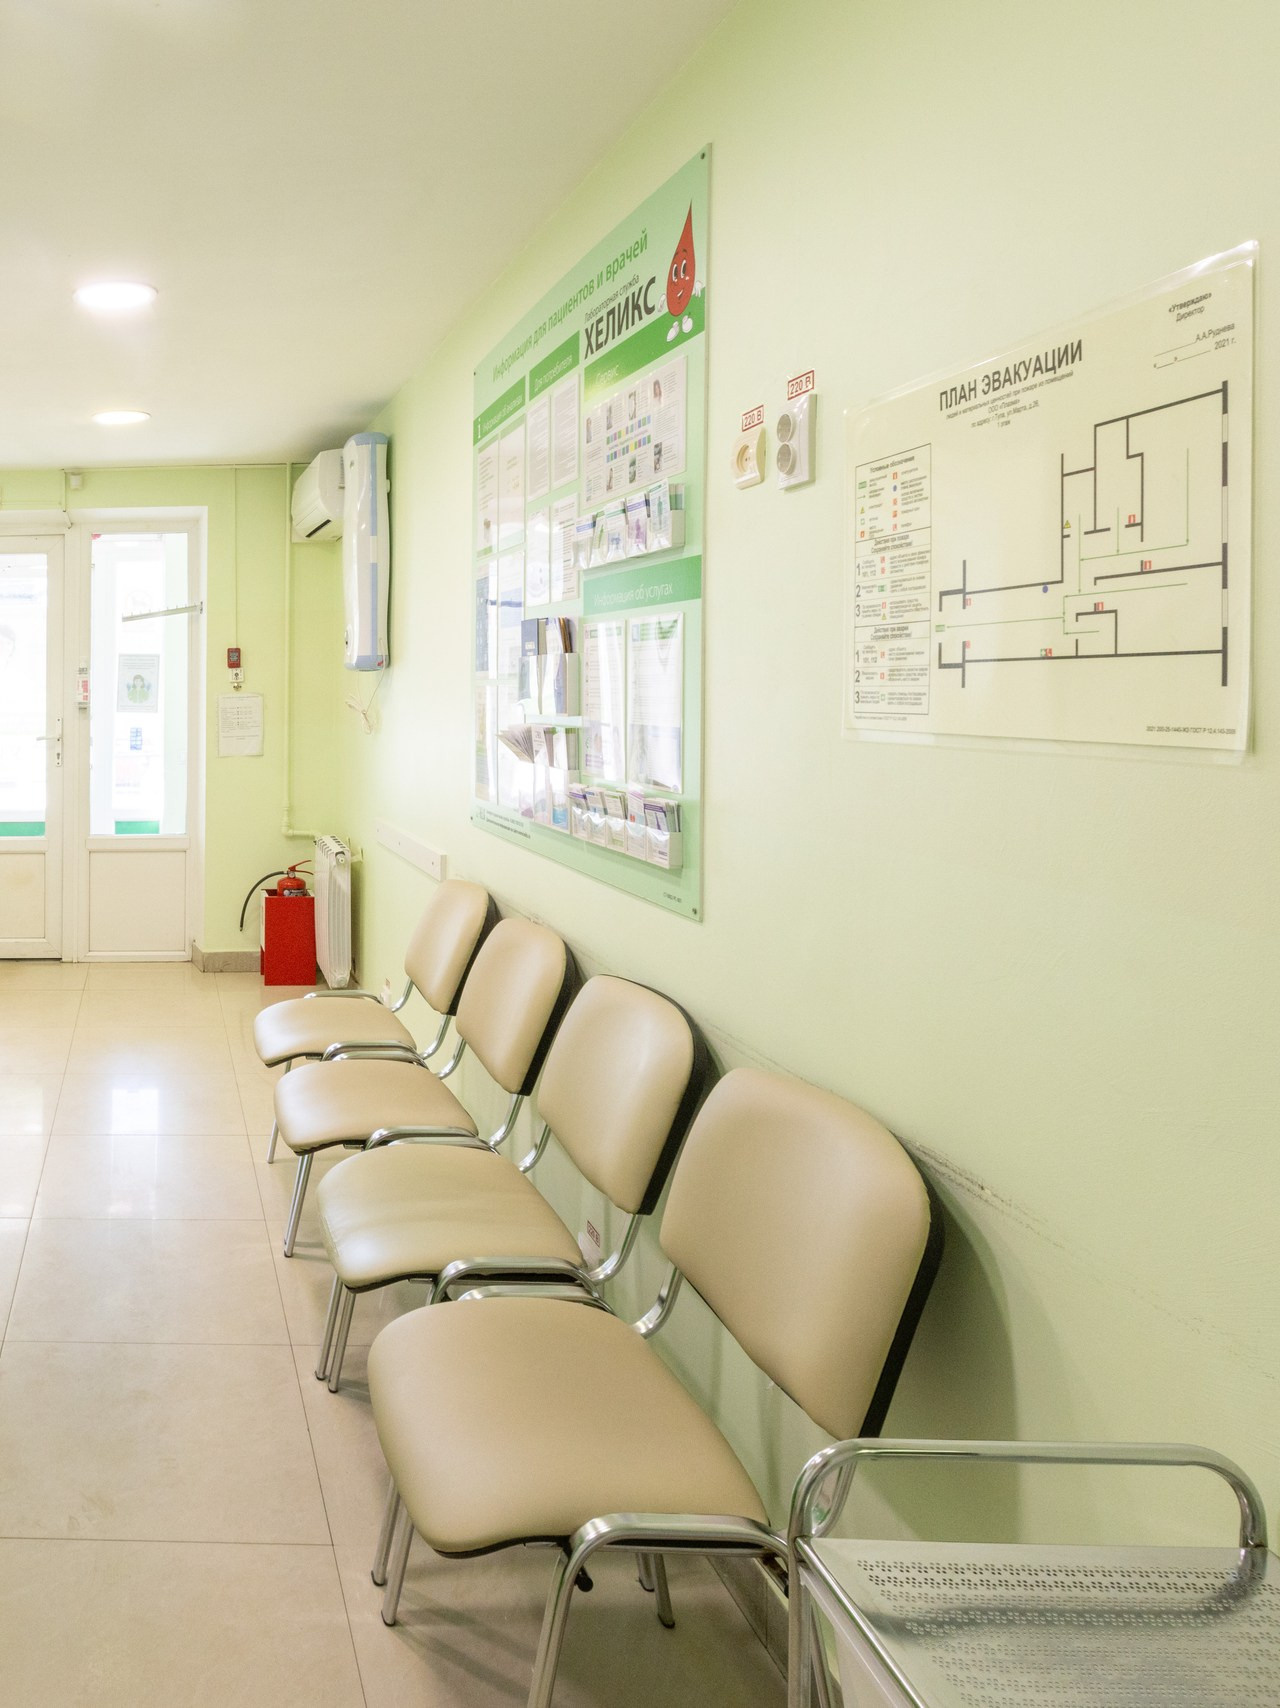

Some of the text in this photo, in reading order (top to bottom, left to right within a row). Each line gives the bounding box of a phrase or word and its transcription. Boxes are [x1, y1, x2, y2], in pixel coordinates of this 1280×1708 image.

[493, 228, 648, 383] Информация для пациентов и врачей
[584, 274, 640, 323] Лабораторная служба
[584, 276, 656, 360] ХЕЛИКС
[1176, 305, 1205, 323] Директор
[1214, 338, 1229, 350] 2021
[939, 339, 1083, 411] ПЛАН ЭВАКУАЦИИ
[789, 380, 803, 395] 220
[744, 410, 762, 428] 220 В
[856, 563, 861, 576] 1
[634, 584, 645, 600] об
[645, 583, 673, 602] услугах
[856, 584, 861, 597] 2
[855, 604, 861, 617] 3
[855, 650, 860, 662] 1
[854, 670, 860, 683] 2
[854, 691, 860, 704] 3
